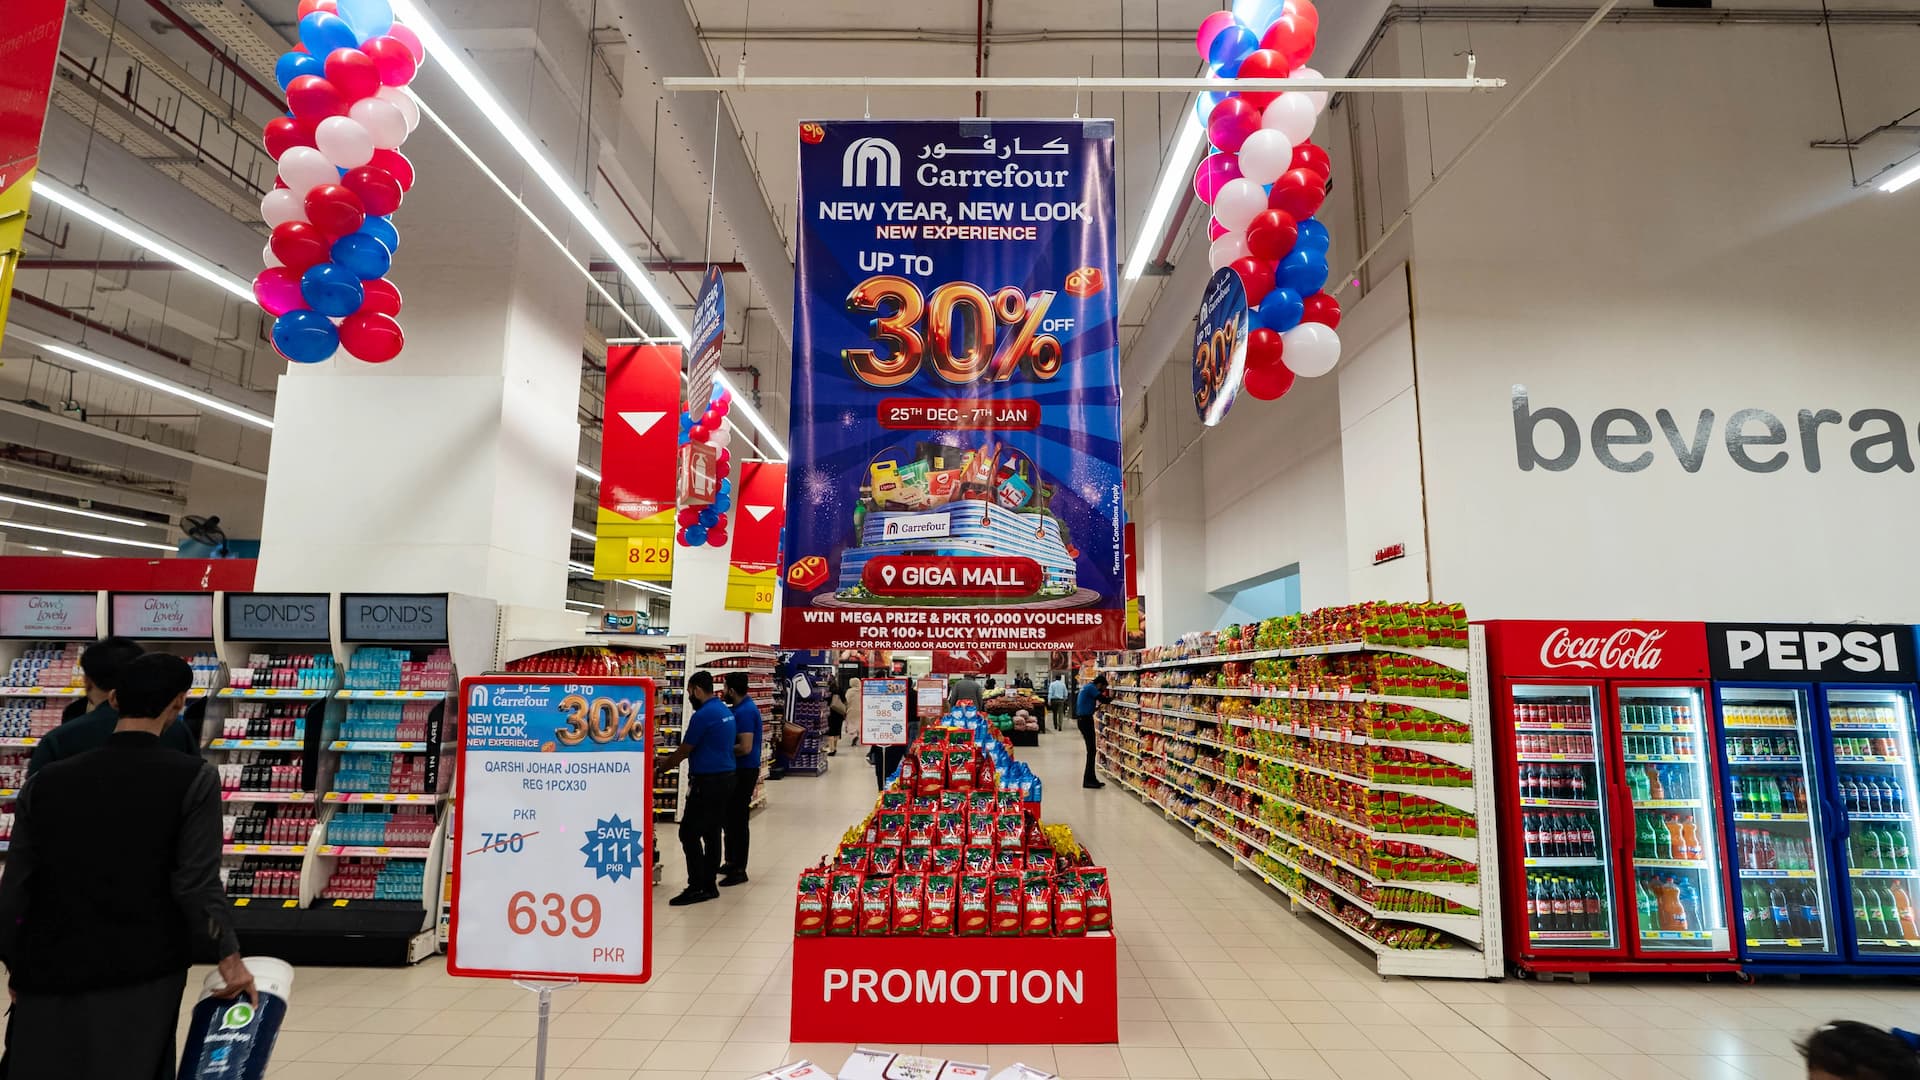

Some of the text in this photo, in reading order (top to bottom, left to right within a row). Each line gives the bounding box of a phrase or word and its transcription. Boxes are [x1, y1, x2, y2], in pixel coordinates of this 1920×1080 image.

[916, 163, 1069, 188] Carrefour
[819, 202, 1093, 225] NEW YEAR, NEW LOOK,
[876, 225, 1037, 240] NEW EXPERIENCE
[858, 251, 934, 276] UP TO
[844, 275, 1062, 388] 30%
[1042, 319, 1075, 332] OFF
[1196, 322, 1212, 347] UP TO
[890, 407, 923, 421] 25TH
[926, 408, 958, 421] DEC
[971, 408, 992, 421] 7TH
[996, 409, 1028, 422] JAN
[1511, 383, 1920, 473] bevera
[1111, 483, 1121, 502] Apply
[616, 503, 659, 514] PROMOTION
[902, 520, 947, 534] Carrefour
[1112, 505, 1121, 542] Conditions
[628, 547, 671, 564] 829
[903, 566, 1025, 586] GIGA MALL
[28, 596, 53, 609] Glow
[143, 598, 169, 611] Glow
[36, 609, 68, 623] Lovely
[152, 610, 184, 624] Lovely
[244, 604, 315, 622] POND'S
[361, 605, 433, 623] POND'S
[803, 611, 1103, 627] WIN MEGA PRIZE & PKR 10,000 VOUCHERS
[860, 627, 1047, 639] FOR 100+ LUCKY WINNERS
[831, 640, 1074, 651] SHOP FOR PKR 10,000 OR ABOVE TO ENTER IN LUCKYDRAW
[1540, 627, 1668, 671] Coca-Cola
[1726, 630, 1901, 673] PEPSI
[564, 684, 593, 695] UP TO
[493, 695, 549, 707] Carrefour
[467, 713, 527, 726] NEW YEAR,
[555, 695, 643, 746] 30%
[876, 709, 893, 718] 985
[467, 726, 527, 739] NEW LOOK,
[467, 738, 539, 747] NEW EXPERIENCE
[485, 761, 631, 775] QARSHI JOHAR JOSHANDA
[522, 778, 587, 791] REG 1PCX30
[513, 809, 536, 820] PKR
[597, 827, 630, 840] SAVE
[481, 833, 524, 853] 750
[592, 843, 632, 863] 111
[606, 864, 624, 872] PKR
[507, 890, 602, 939] 639
[593, 948, 625, 962] PKR
[822, 968, 1084, 1005] PROMOTION
